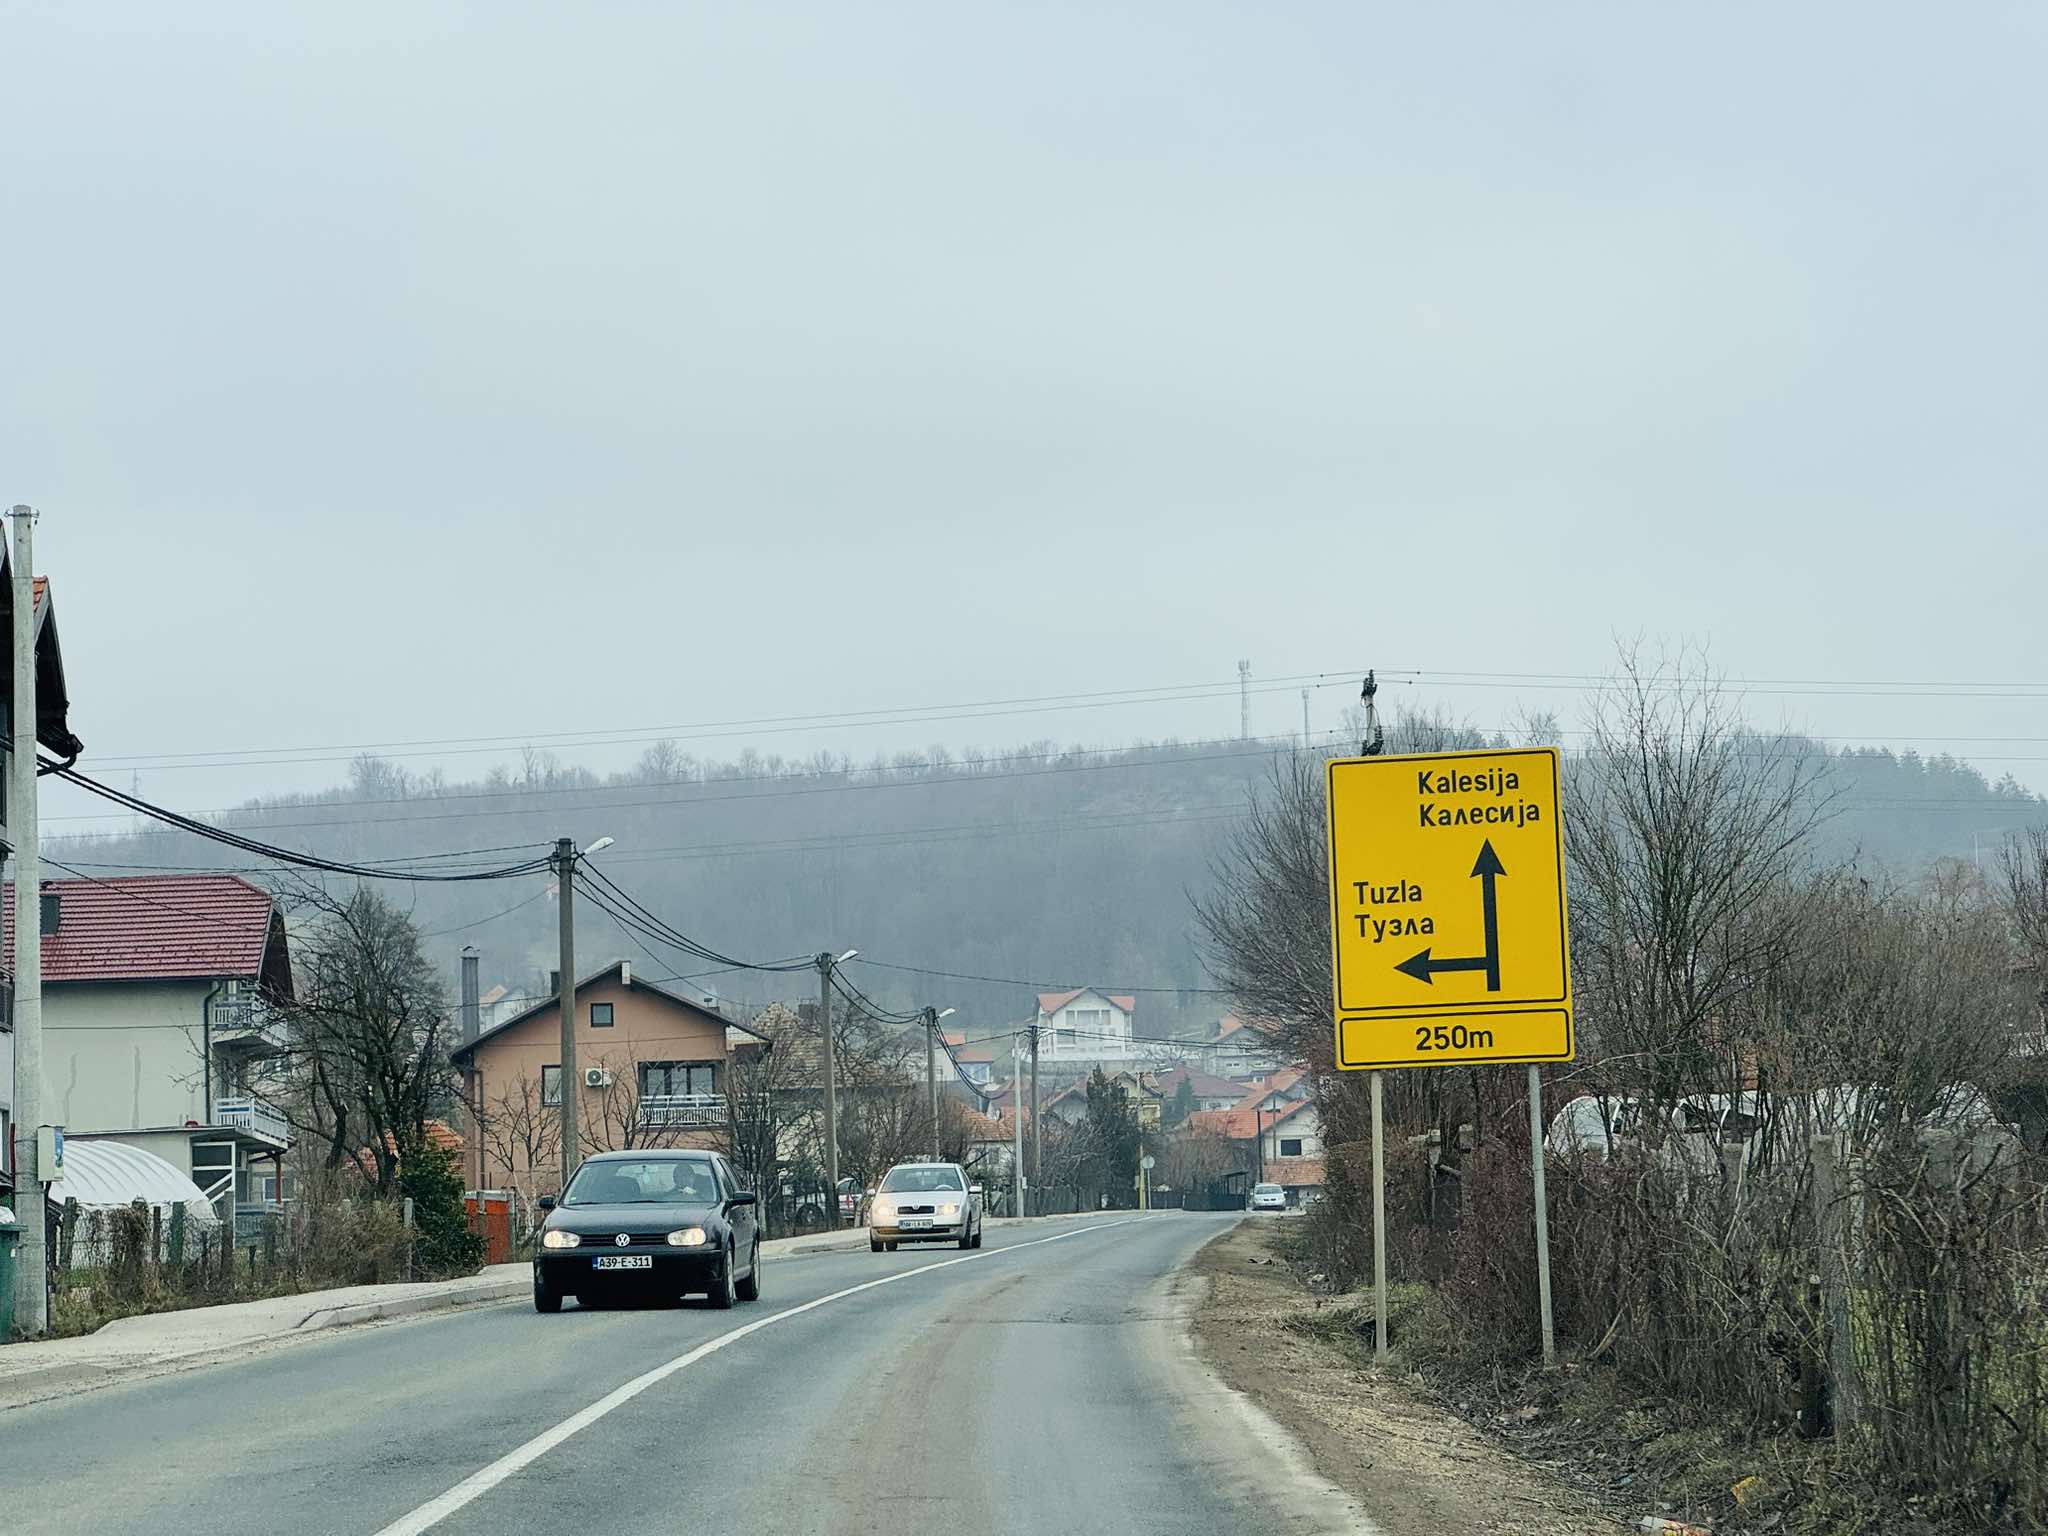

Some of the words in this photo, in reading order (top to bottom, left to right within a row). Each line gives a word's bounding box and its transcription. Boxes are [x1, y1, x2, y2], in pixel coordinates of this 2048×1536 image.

[1418, 768, 1519, 796] Kalesija
[1420, 800, 1540, 828] Калесија
[1353, 879, 1422, 905] Tuzla
[1354, 913, 1435, 943] Тузла
[1415, 1025, 1493, 1051] 250m
[599, 1256, 651, 1268] A39-E-311
